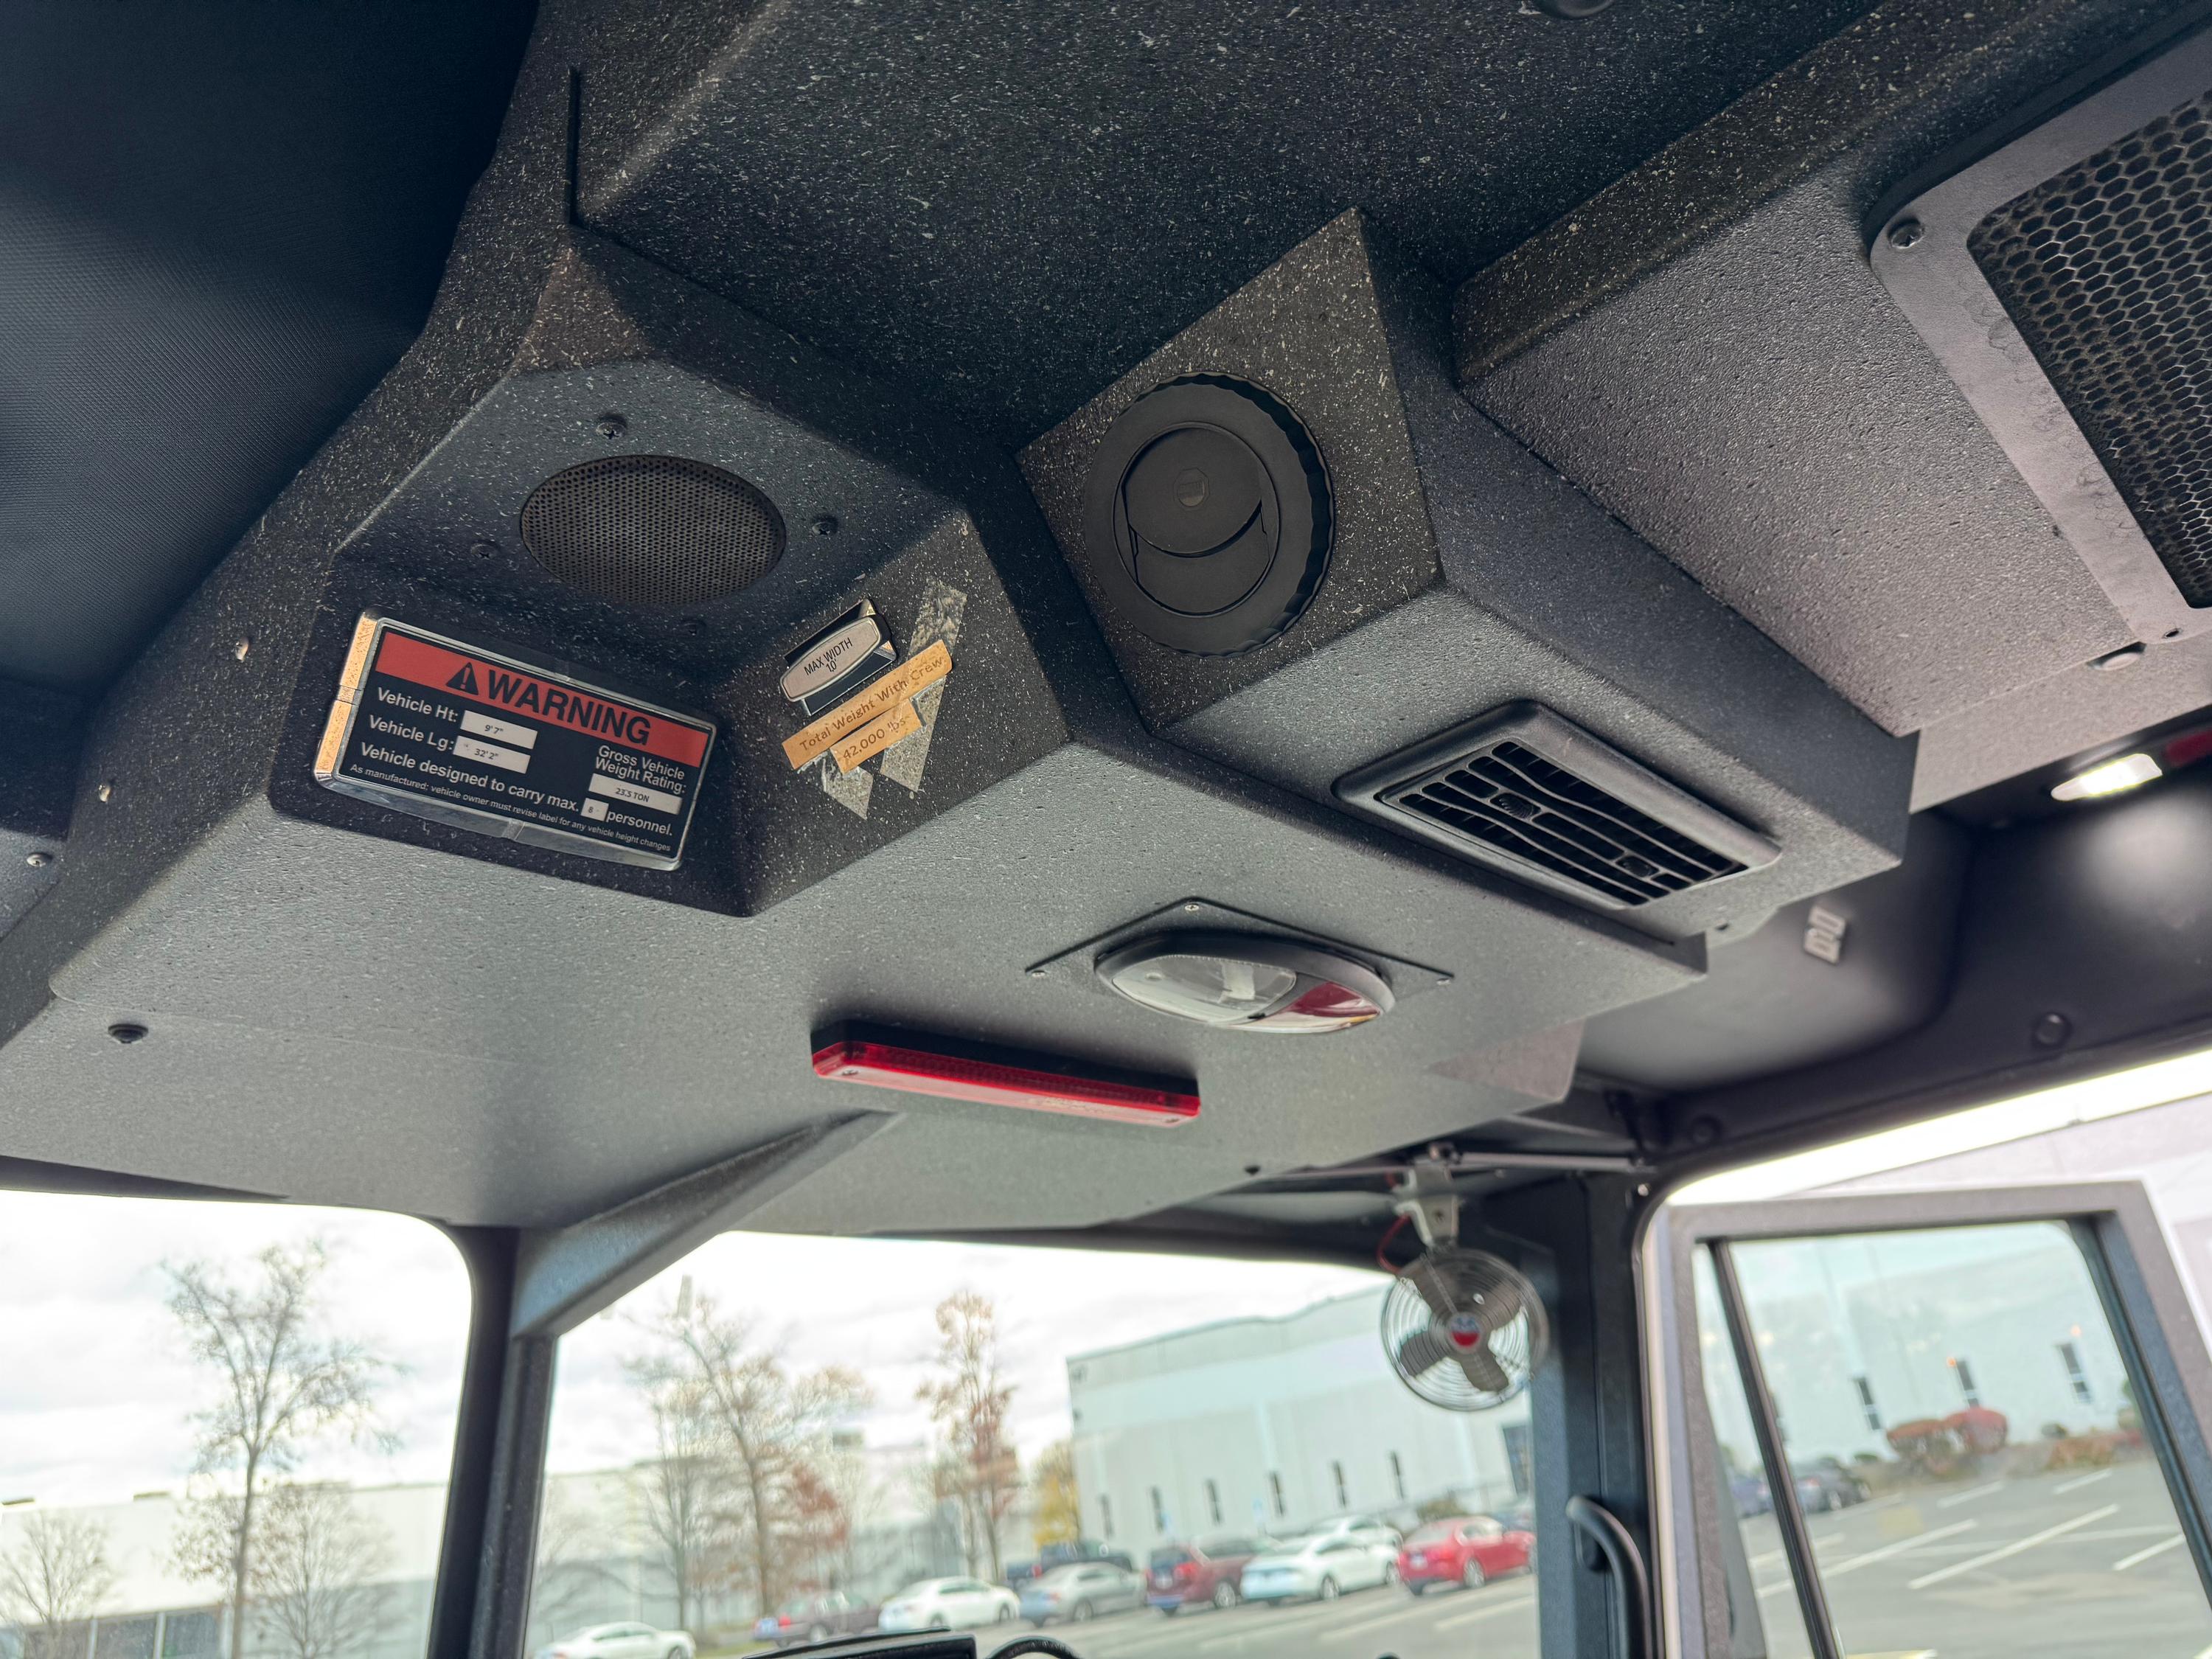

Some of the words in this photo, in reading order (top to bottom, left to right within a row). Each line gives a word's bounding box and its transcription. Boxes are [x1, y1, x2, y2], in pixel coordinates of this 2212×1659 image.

[804, 656, 824, 675] MAX
[823, 637, 852, 661] WIDTH
[378, 686, 433, 714] Vehicle
[436, 705, 459, 723] Ht:
[488, 669, 650, 745] WARNING
[799, 728, 831, 751] Total
[833, 699, 875, 730] Weight
[877, 679, 908, 703] With
[910, 657, 943, 681] Crew
[369, 714, 425, 742] Vehicle
[427, 732, 454, 751] Lg:
[843, 728, 886, 759] 42,000
[596, 756, 640, 780] Weight
[642, 771, 687, 795] Rating:
[598, 745, 638, 766] Gross
[641, 757, 685, 780] Vehicle
[349, 764, 364, 773] As
[365, 768, 428, 790] manufactured:
[431, 785, 462, 799] vehicle
[462, 793, 490, 805] owner
[490, 800, 512, 811] must
[512, 807, 538, 818] revise
[538, 812, 558, 823] label
[559, 817, 571, 826] for
[571, 821, 586, 832] any
[588, 824, 614, 838] vehicle
[616, 831, 639, 845] height
[640, 838, 671, 851] changes
[361, 742, 416, 768] Vehicle
[419, 759, 488, 787] designed
[490, 778, 505, 792] to
[508, 785, 546, 804] carry
[547, 795, 579, 812] max.
[606, 810, 673, 836] personnel.
[615, 787, 632, 798] 23.5
[633, 792, 650, 803] TON
